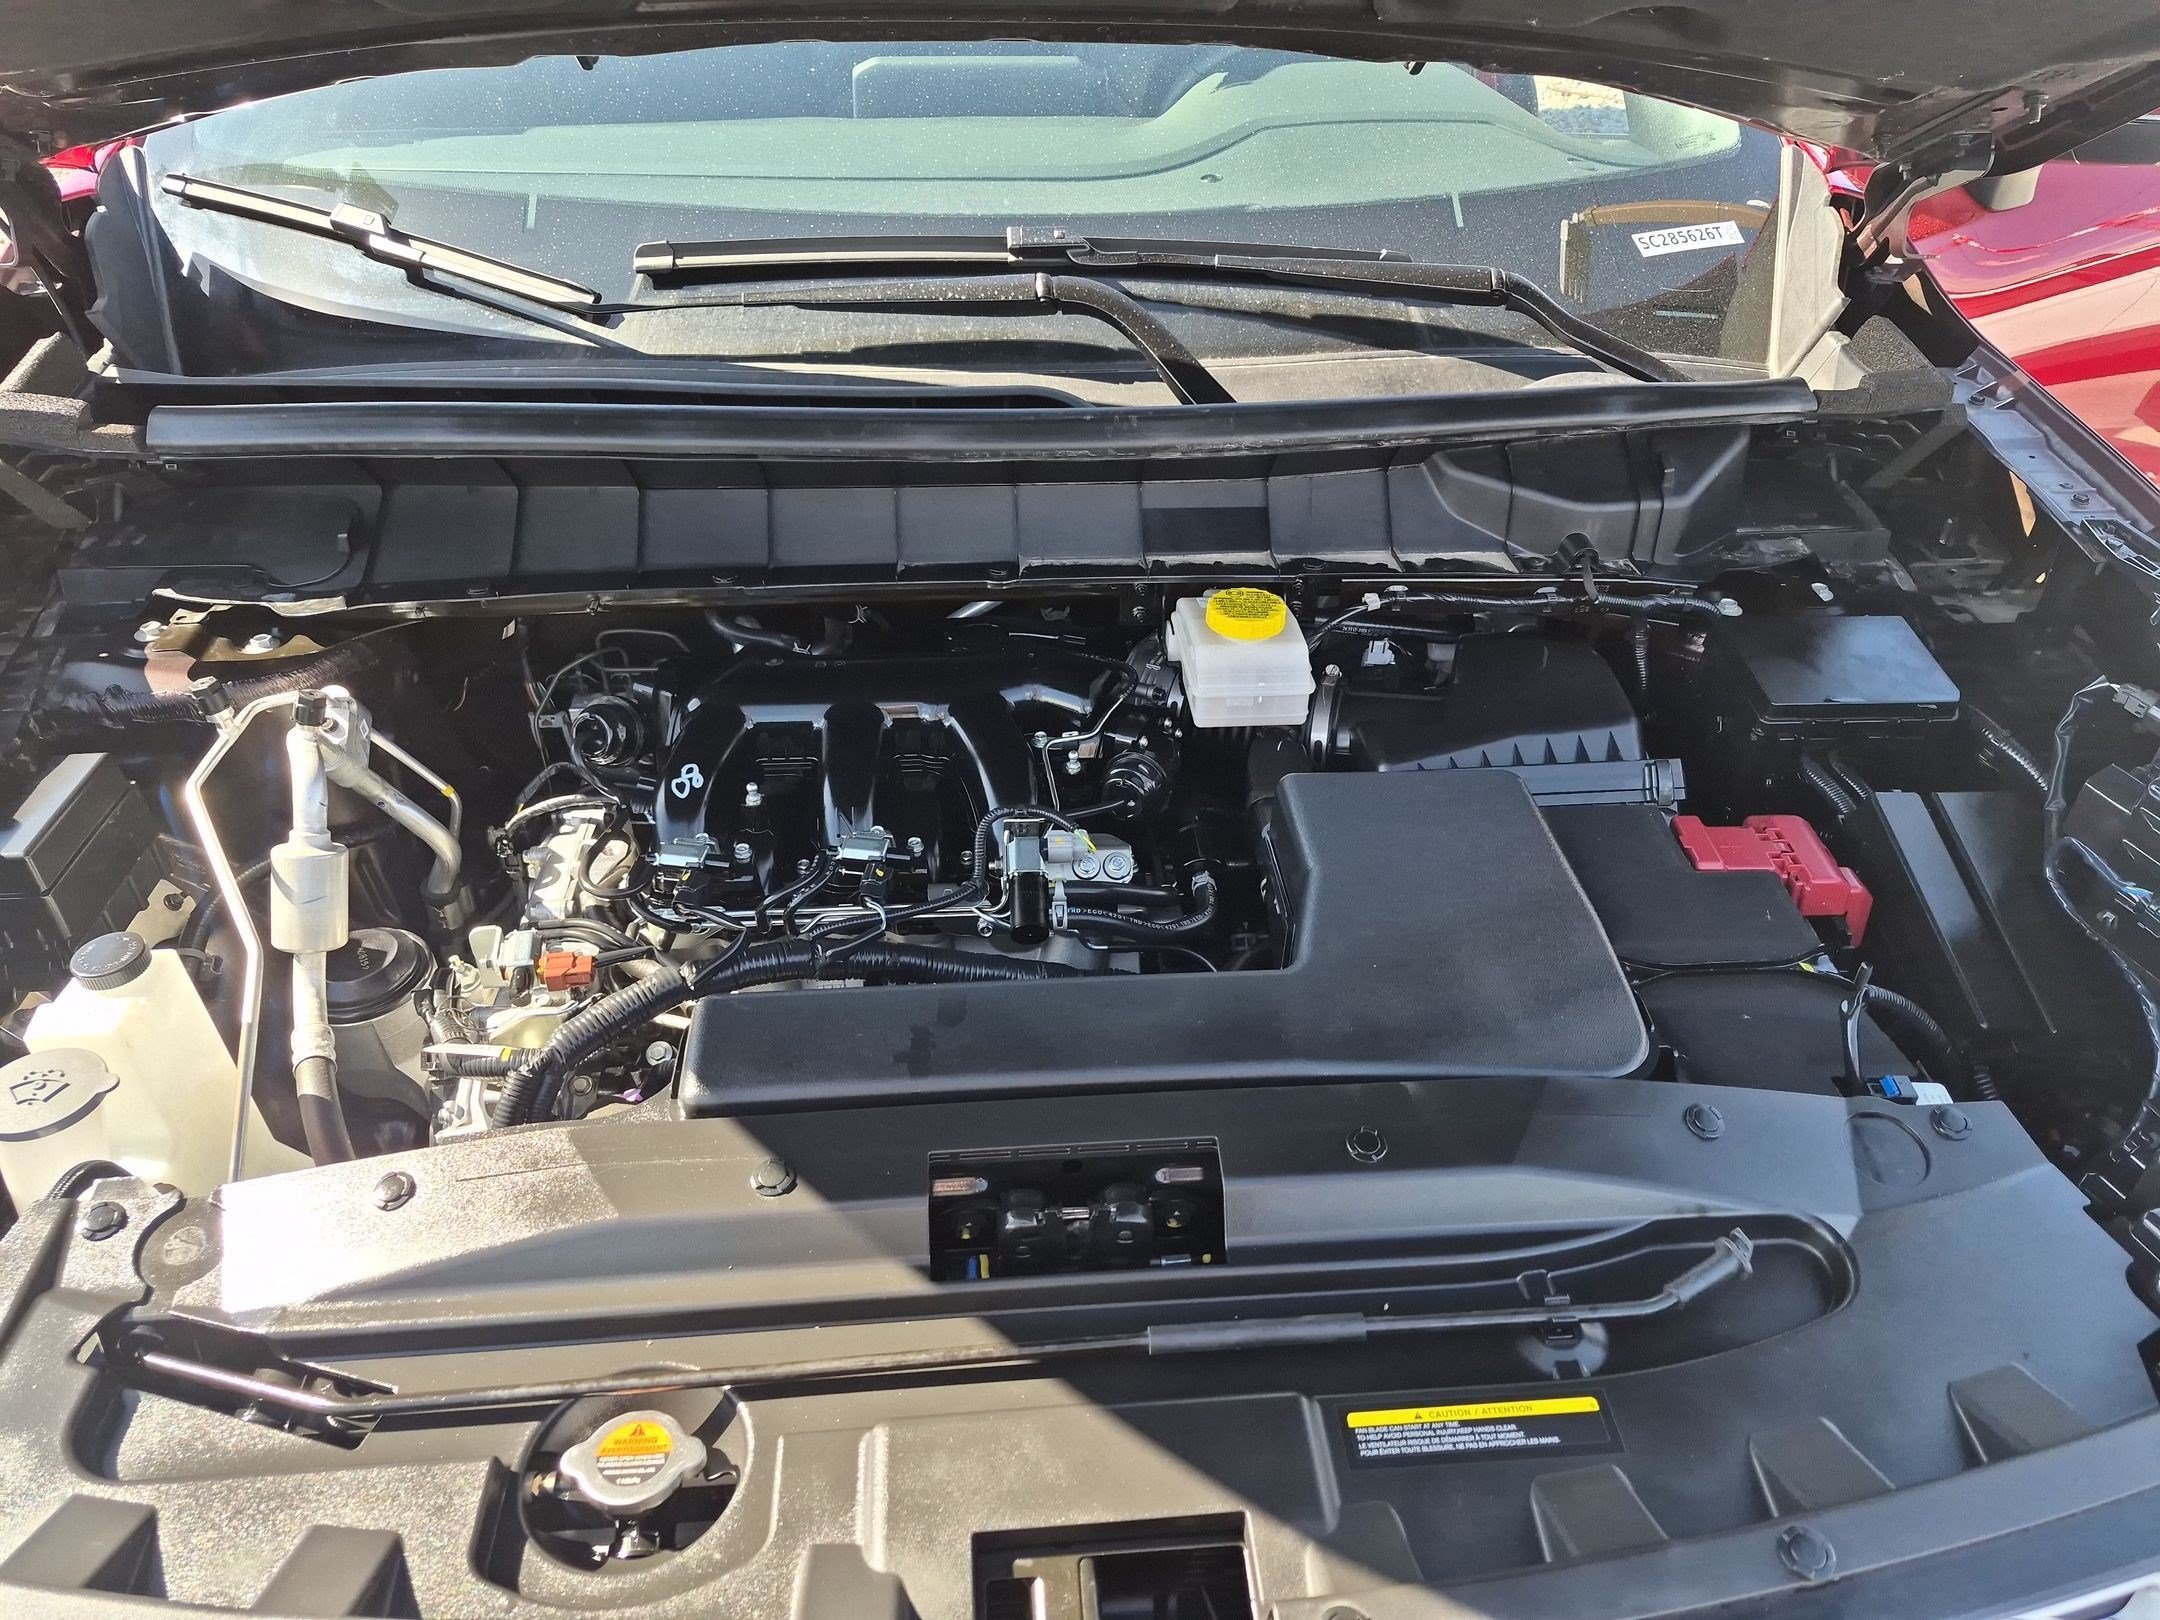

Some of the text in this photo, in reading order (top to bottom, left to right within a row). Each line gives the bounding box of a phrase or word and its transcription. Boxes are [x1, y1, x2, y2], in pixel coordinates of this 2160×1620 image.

[1638, 226, 1724, 250] SC285626T
[1428, 1408, 1471, 1419] CAUTION
[1482, 1404, 1533, 1415] ATTENTION
[614, 1436, 658, 1446] WARNING
[1367, 1433, 1382, 1441] HELP
[601, 1444, 667, 1454] AVERTISSEMENT
